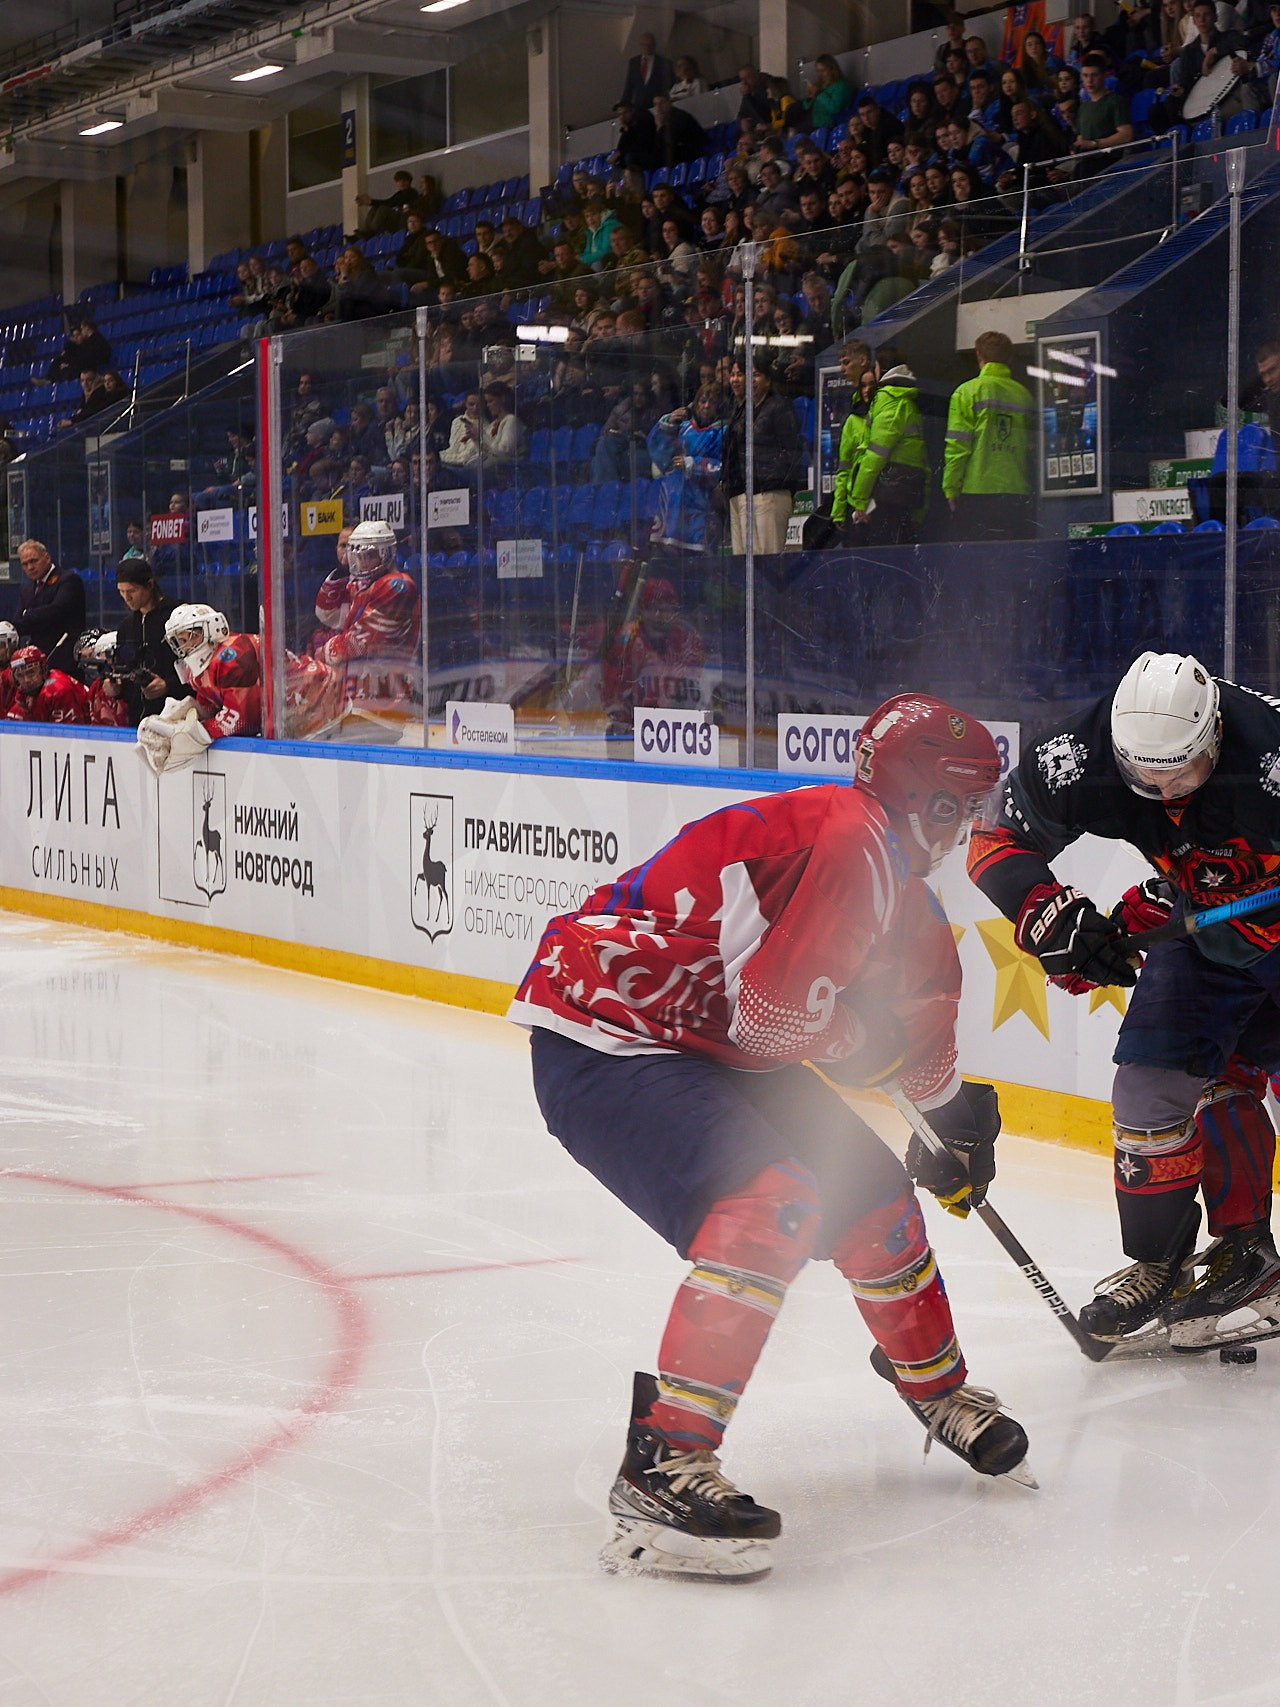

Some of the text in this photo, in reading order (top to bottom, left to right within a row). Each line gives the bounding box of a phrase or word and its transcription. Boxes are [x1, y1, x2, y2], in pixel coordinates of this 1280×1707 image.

[346, 119, 353, 144] 2
[152, 517, 184, 540] FONBET
[363, 500, 401, 523] KHL.RU
[461, 725, 508, 744] Ростелеком
[641, 718, 711, 756] согаз
[1134, 754, 1188, 764] ГАЗПРОМБАНК
[27, 750, 121, 830] ЛИГА
[234, 802, 299, 843] НИЖНИЙ
[464, 817, 619, 866] ПРАВИТЕЛЬСТВО
[31, 845, 120, 892] СИЛЬНЫХ
[234, 849, 314, 898] НОВГОРОД
[464, 905, 533, 943] ОБЛАСТИ
[1030, 889, 1088, 946] BAUE
